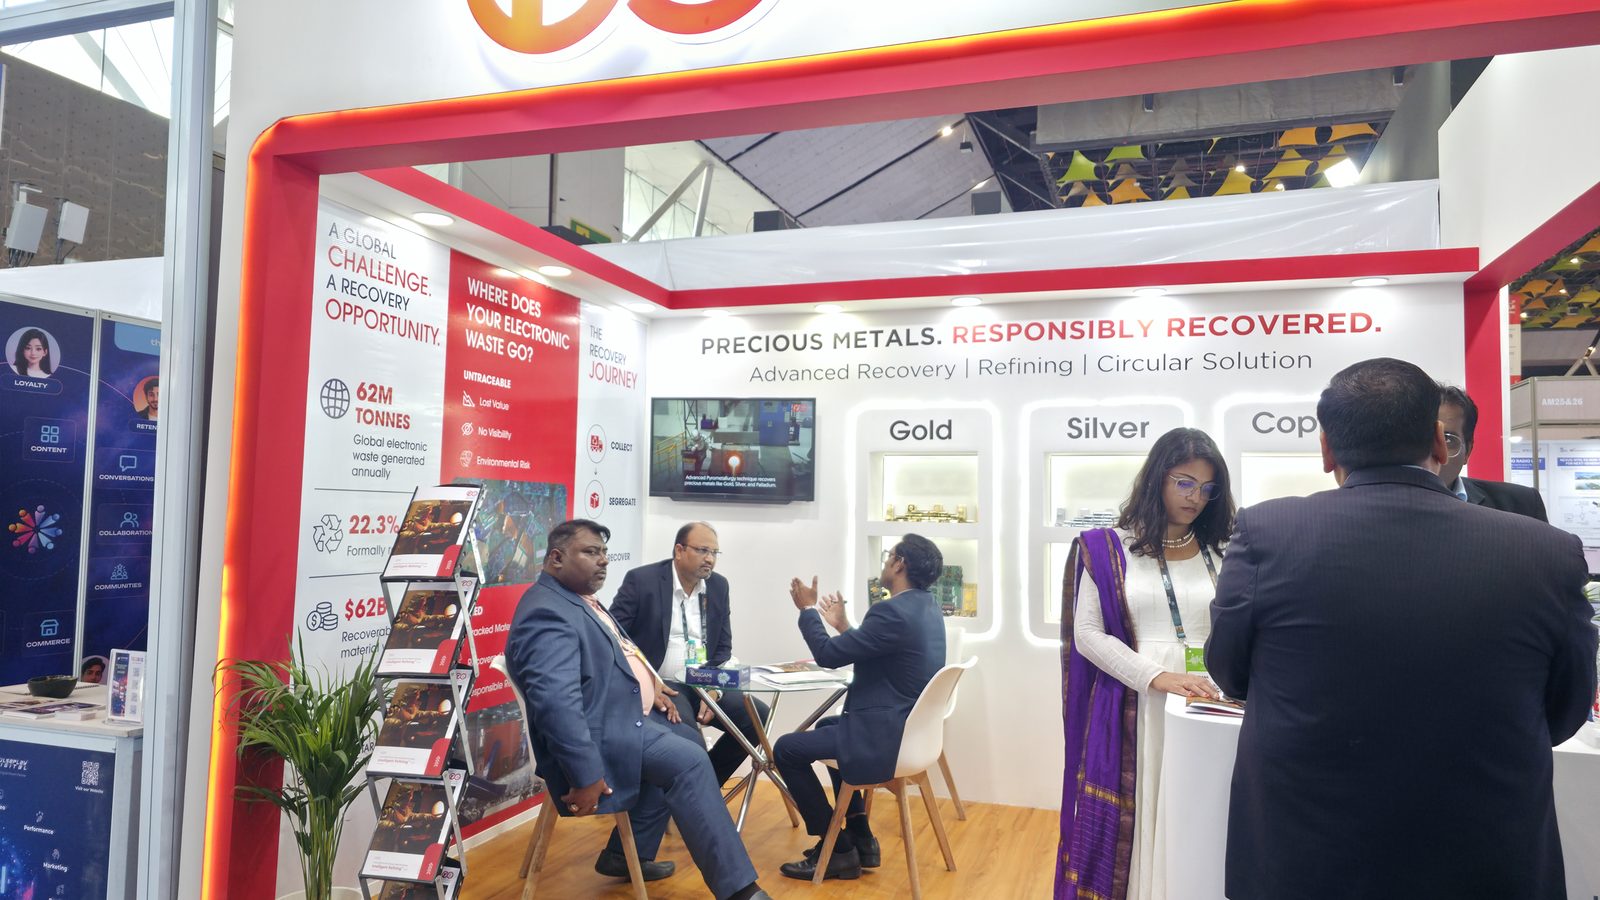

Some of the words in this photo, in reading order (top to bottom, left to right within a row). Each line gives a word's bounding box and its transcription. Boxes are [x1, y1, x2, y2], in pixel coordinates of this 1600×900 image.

[329, 222, 339, 239] A
[343, 228, 396, 260] GLOBAL
[328, 245, 432, 297] CHALLENGE.
[326, 274, 337, 291] A
[341, 277, 410, 311] RECOVERY
[467, 277, 508, 307] WHERE
[511, 293, 541, 318] DOES
[325, 298, 440, 346] OPPORTUNITY.
[466, 303, 501, 330] YOUR
[504, 315, 570, 350] ELECTRONIC
[589, 324, 602, 341] THE
[701, 333, 823, 354] PRECIOUS
[833, 327, 942, 350] METALS.
[952, 318, 1155, 344] RESPONSIBLY
[1167, 312, 1382, 338] RECOVERED.
[466, 329, 504, 356] WASTE
[507, 341, 534, 363] GO?
[589, 343, 627, 366] RECOVERY
[589, 360, 638, 390] JOURNEY
[750, 363, 850, 383] Advanced
[857, 357, 956, 382] Recovery
[979, 355, 1073, 378] Refining
[1097, 353, 1193, 373] Circular
[1203, 351, 1312, 371] Solution
[14, 379, 48, 389] LOYALTY
[464, 370, 511, 389] UNTRACEABLE
[356, 382, 393, 405] 62M
[479, 397, 491, 410] Lost
[491, 399, 509, 411] Value
[355, 407, 411, 430] TONNES
[478, 426, 488, 436] No
[489, 427, 512, 441] Visibility
[889, 419, 953, 441] Gold
[1067, 416, 1150, 440] Silver
[31, 445, 67, 454] CONTENT
[353, 434, 384, 448] Global
[386, 439, 428, 451] electronic
[611, 441, 633, 452] COLLECT
[352, 451, 379, 462] waste
[381, 454, 425, 466] generated
[477, 455, 519, 469] Environmental
[520, 459, 531, 470] Risk
[99, 474, 154, 482] CONVERSATIONS
[351, 467, 391, 480] annually
[349, 515, 400, 535] 22.3%
[346, 545, 385, 557] Formally
[608, 552, 631, 562] RECOVER
[94, 582, 142, 591] COMMUNITIES
[26, 638, 71, 648] COMMERCE
[24, 824, 54, 835] Performance
[43, 862, 68, 873] Marketing
